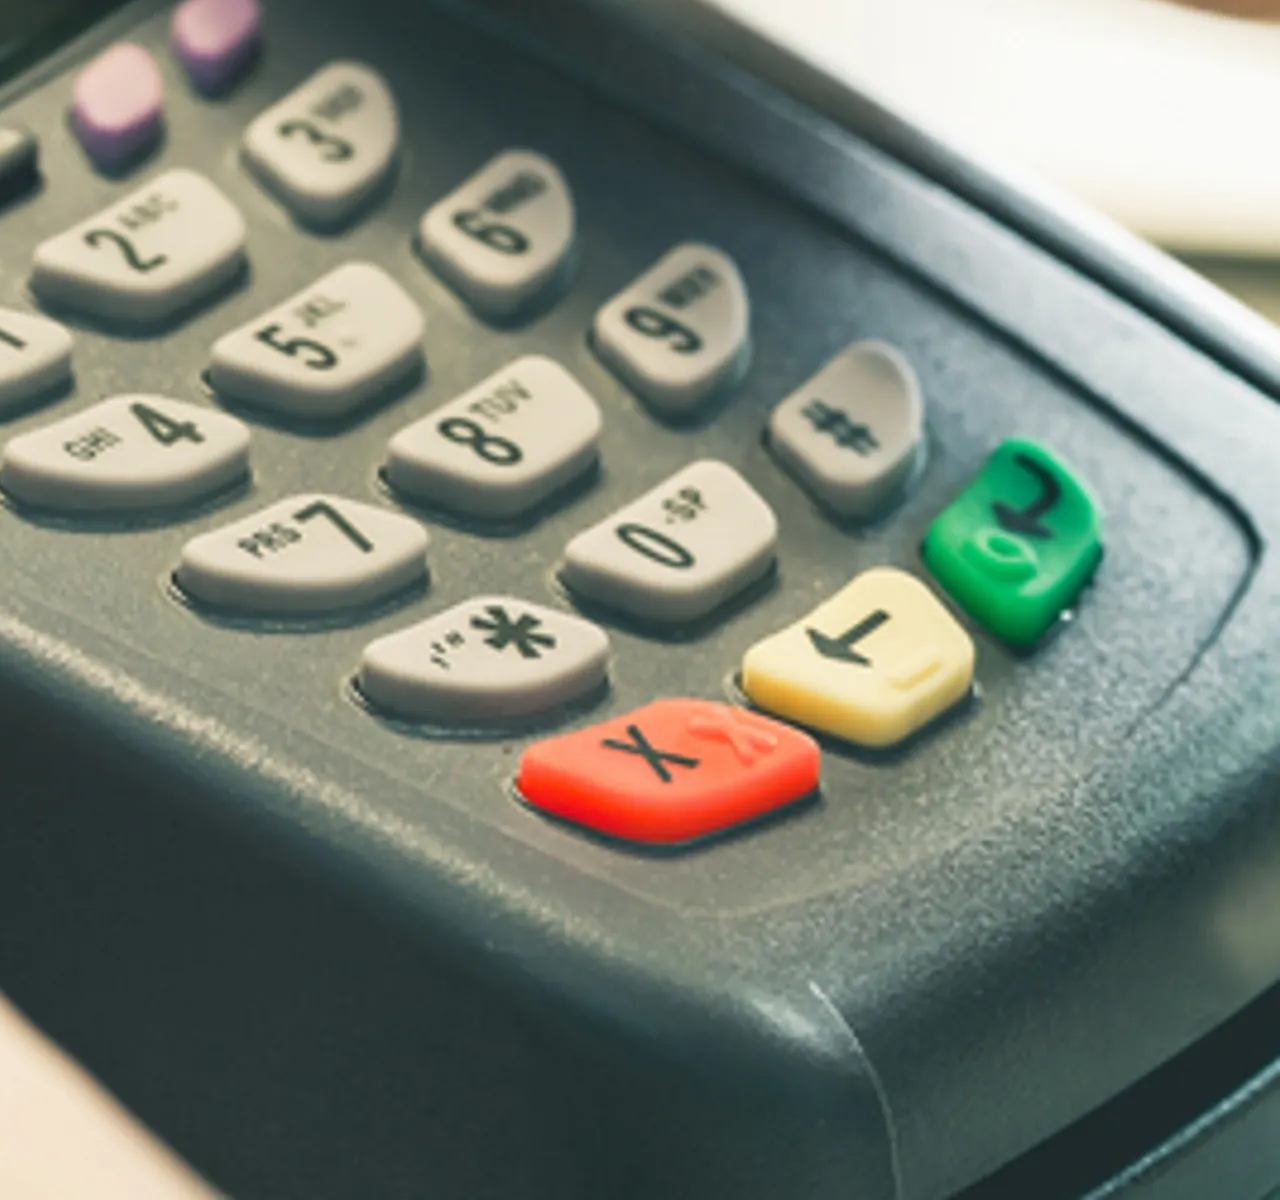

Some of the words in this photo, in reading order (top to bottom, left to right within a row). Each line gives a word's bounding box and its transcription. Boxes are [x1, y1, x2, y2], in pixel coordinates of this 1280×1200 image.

[277, 119, 355, 163] 3
[83, 229, 168, 274] 2
[453, 209, 530, 255] 6
[253, 323, 338, 371] 5
[624, 306, 703, 354] 9
[130, 402, 206, 447] 4
[437, 416, 523, 466] 8
[293, 500, 374, 553] 7
[614, 523, 696, 569] 0
